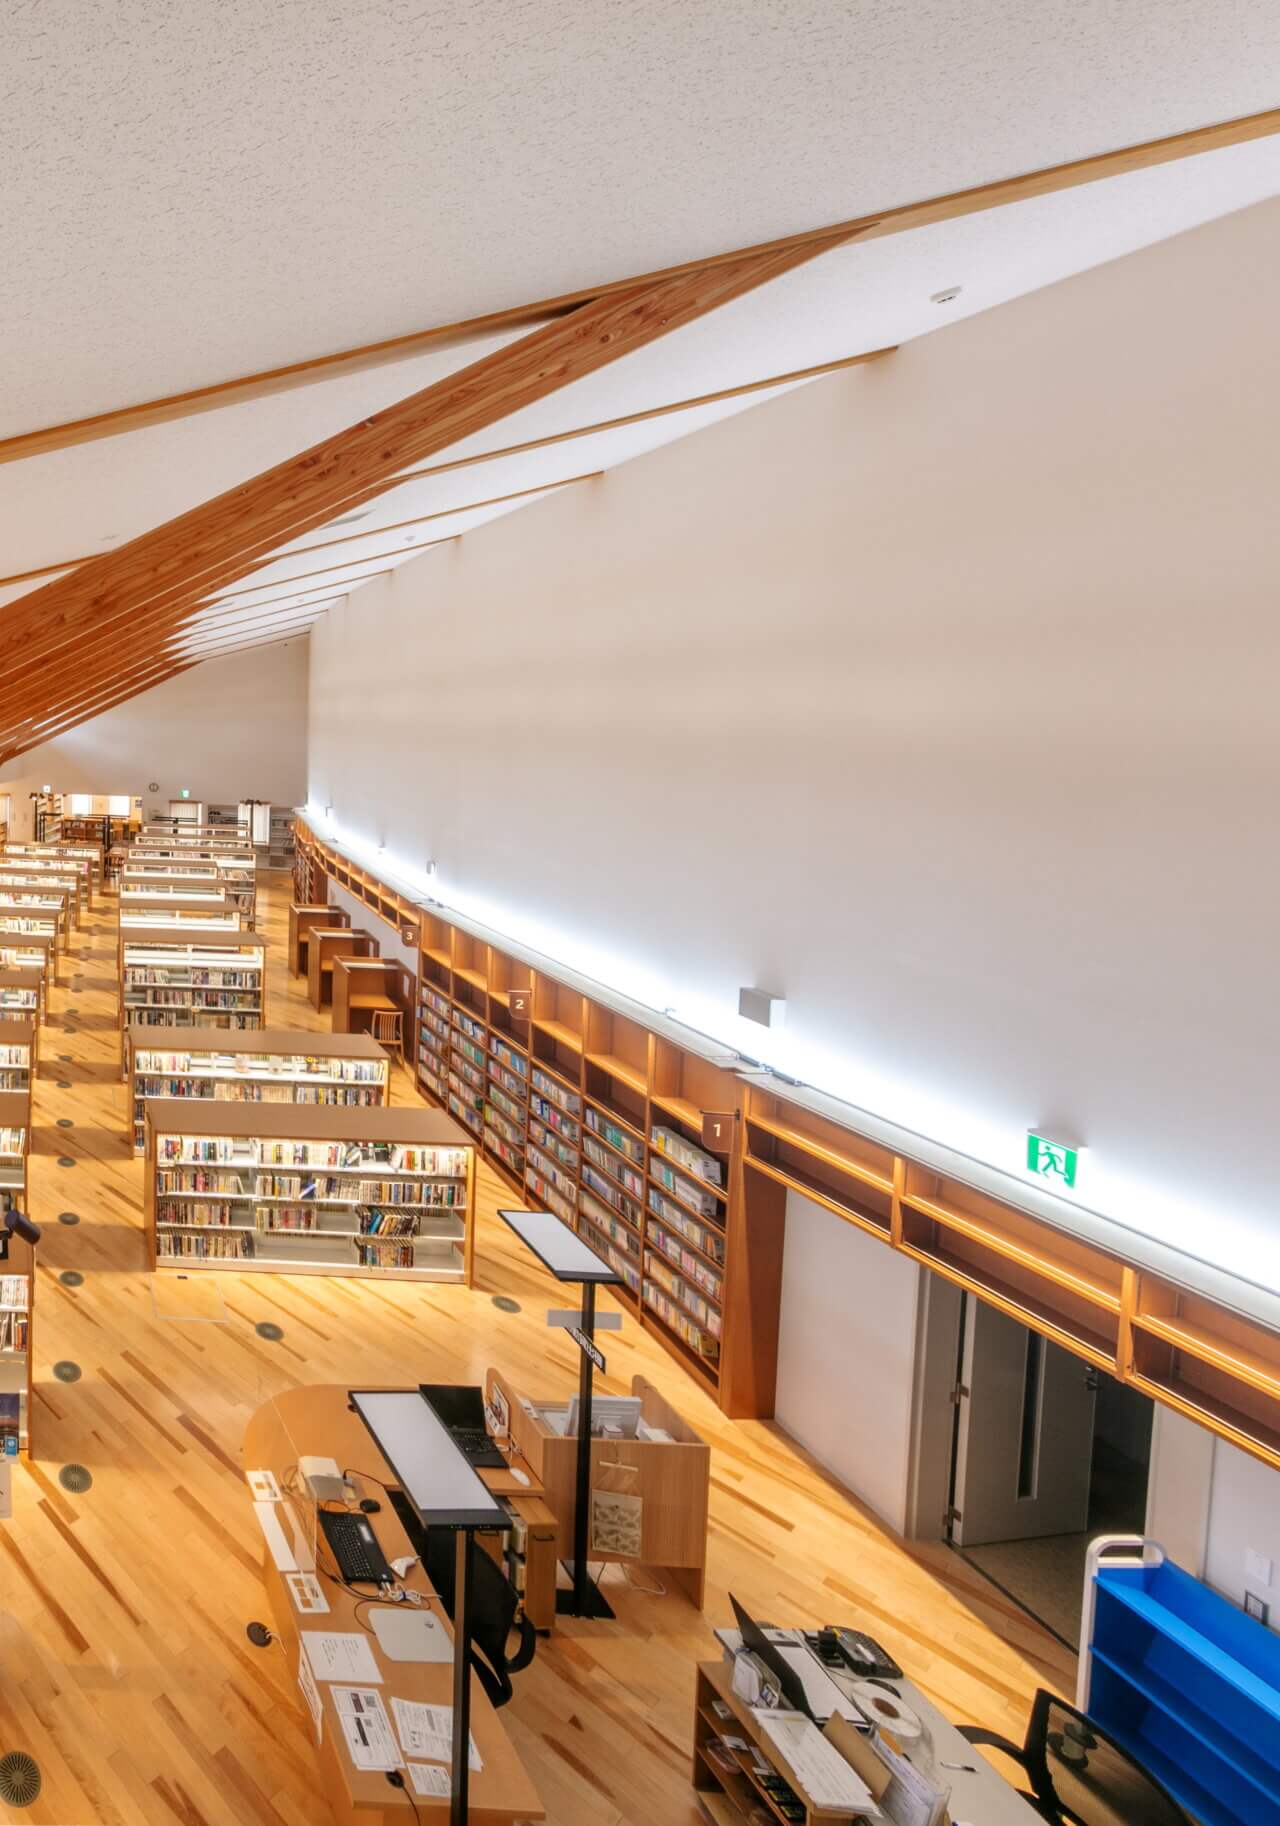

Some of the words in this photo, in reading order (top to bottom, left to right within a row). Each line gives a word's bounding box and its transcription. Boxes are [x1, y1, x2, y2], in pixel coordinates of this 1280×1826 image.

[406, 931, 413, 940] 3
[515, 999, 525, 1009] 2
[713, 1123, 721, 1137] 1
